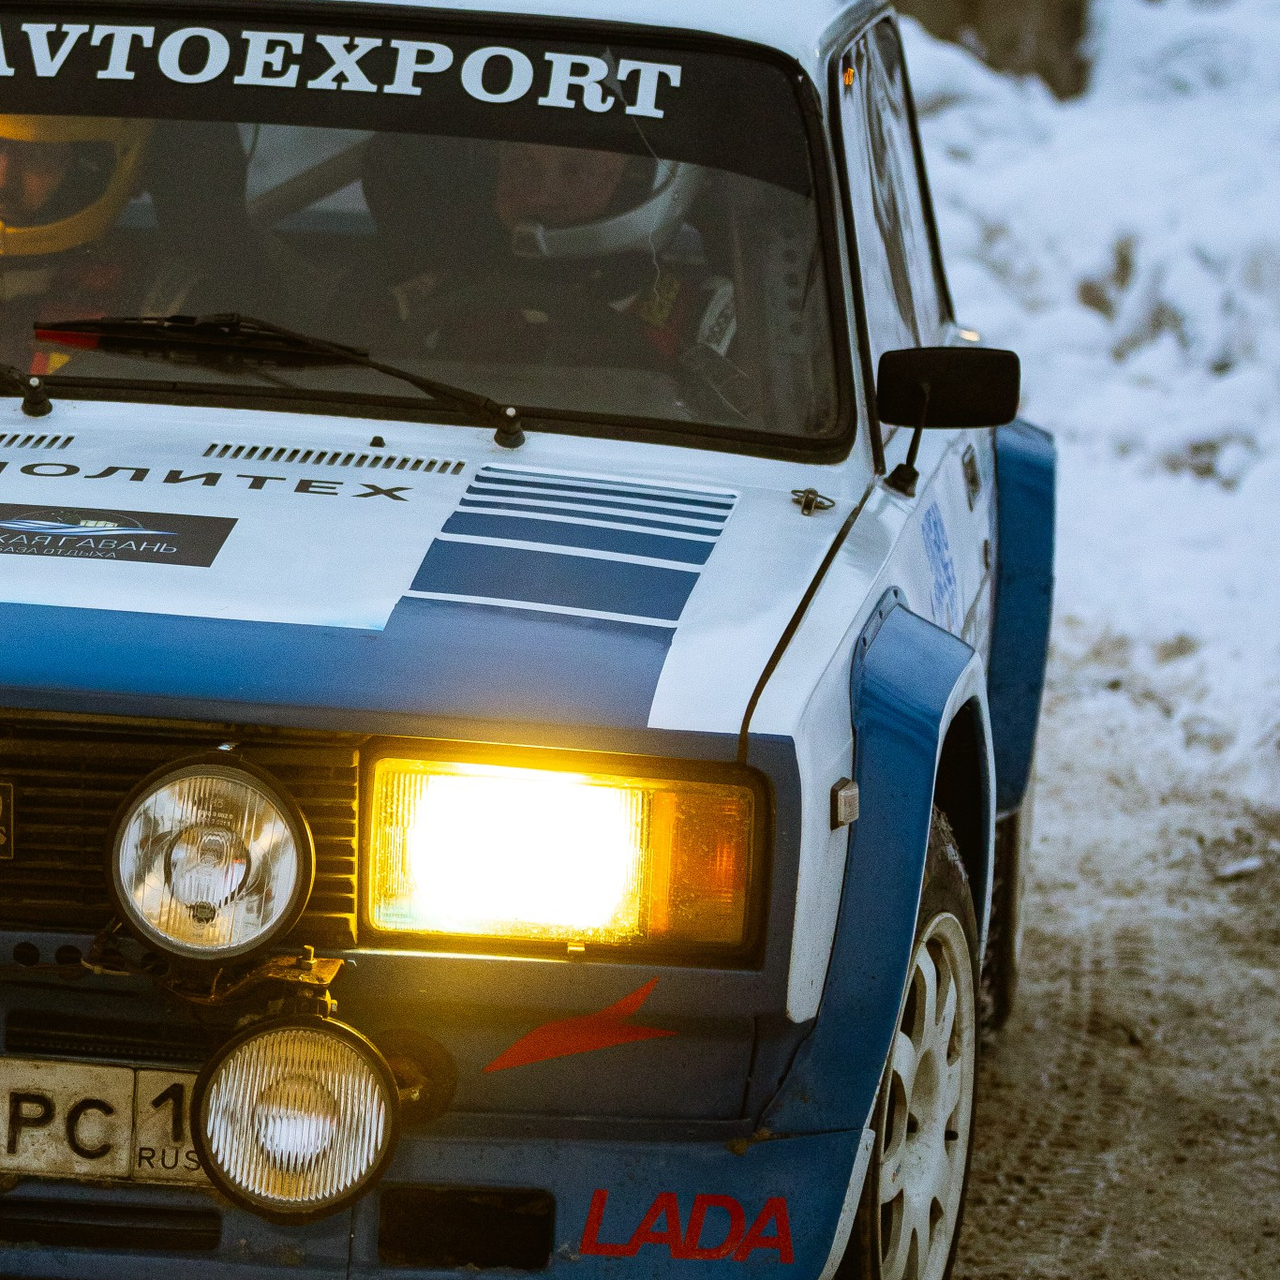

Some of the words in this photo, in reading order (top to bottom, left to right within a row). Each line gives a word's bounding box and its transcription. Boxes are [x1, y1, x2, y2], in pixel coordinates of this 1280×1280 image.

[43, 547, 117, 559] ОТДЫХА
[57, 535, 178, 554] ГАВАНЬ
[137, 1146, 201, 1172] RUS
[578, 1188, 795, 1265] LADA
